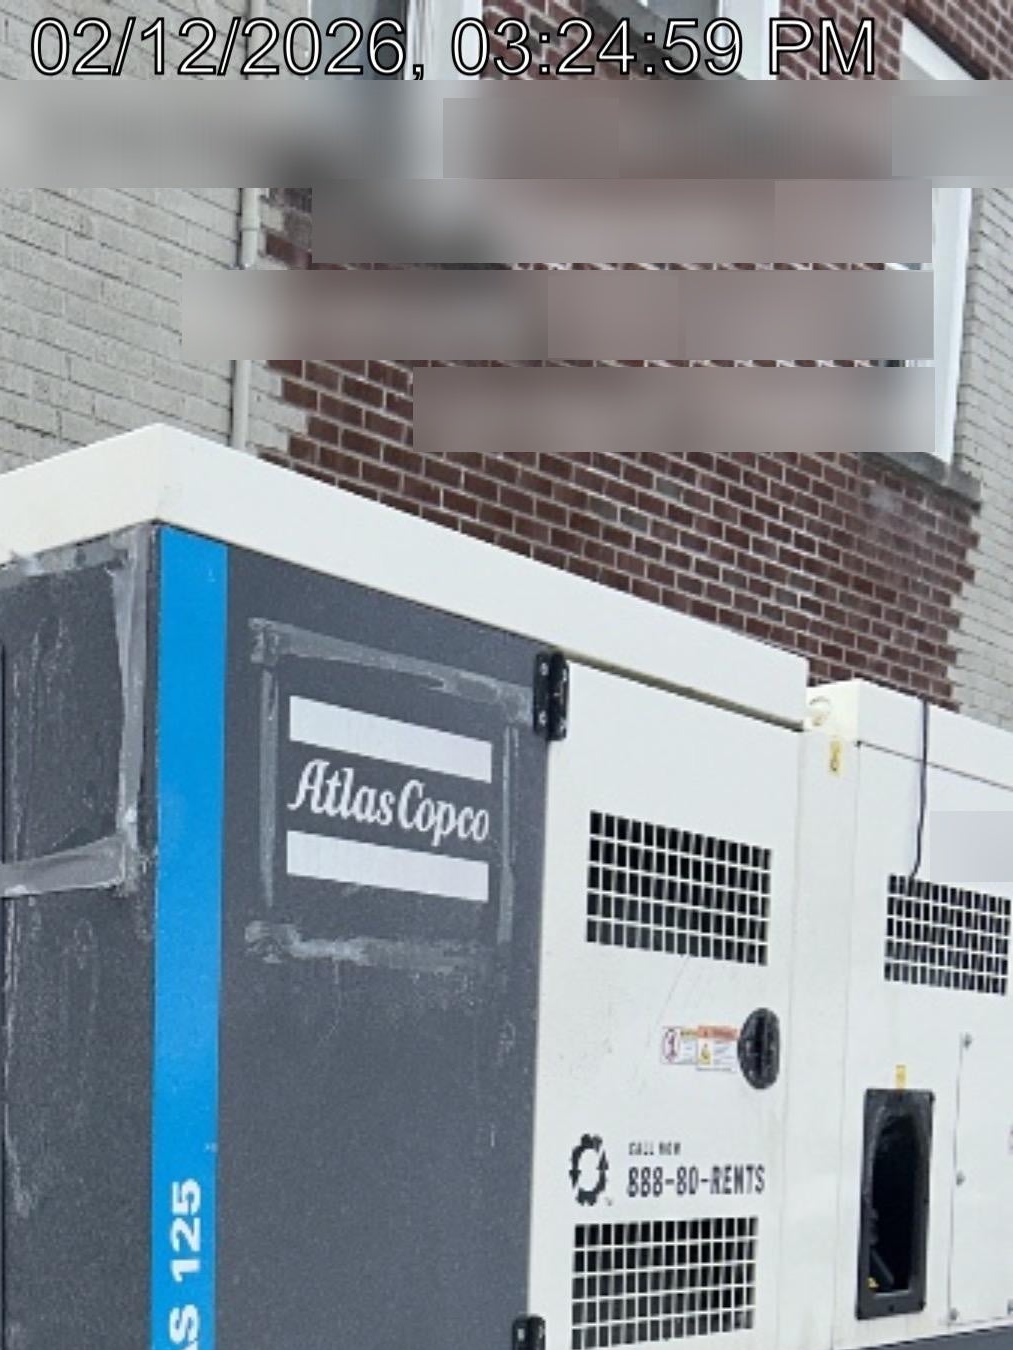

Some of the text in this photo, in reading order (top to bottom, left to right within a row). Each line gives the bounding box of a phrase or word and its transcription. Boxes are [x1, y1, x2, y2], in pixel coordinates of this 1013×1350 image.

[287, 758, 489, 847] Atlas Copco
[627, 1163, 765, 1198] 888-80-RENTS
[169, 1177, 202, 1283] 125
